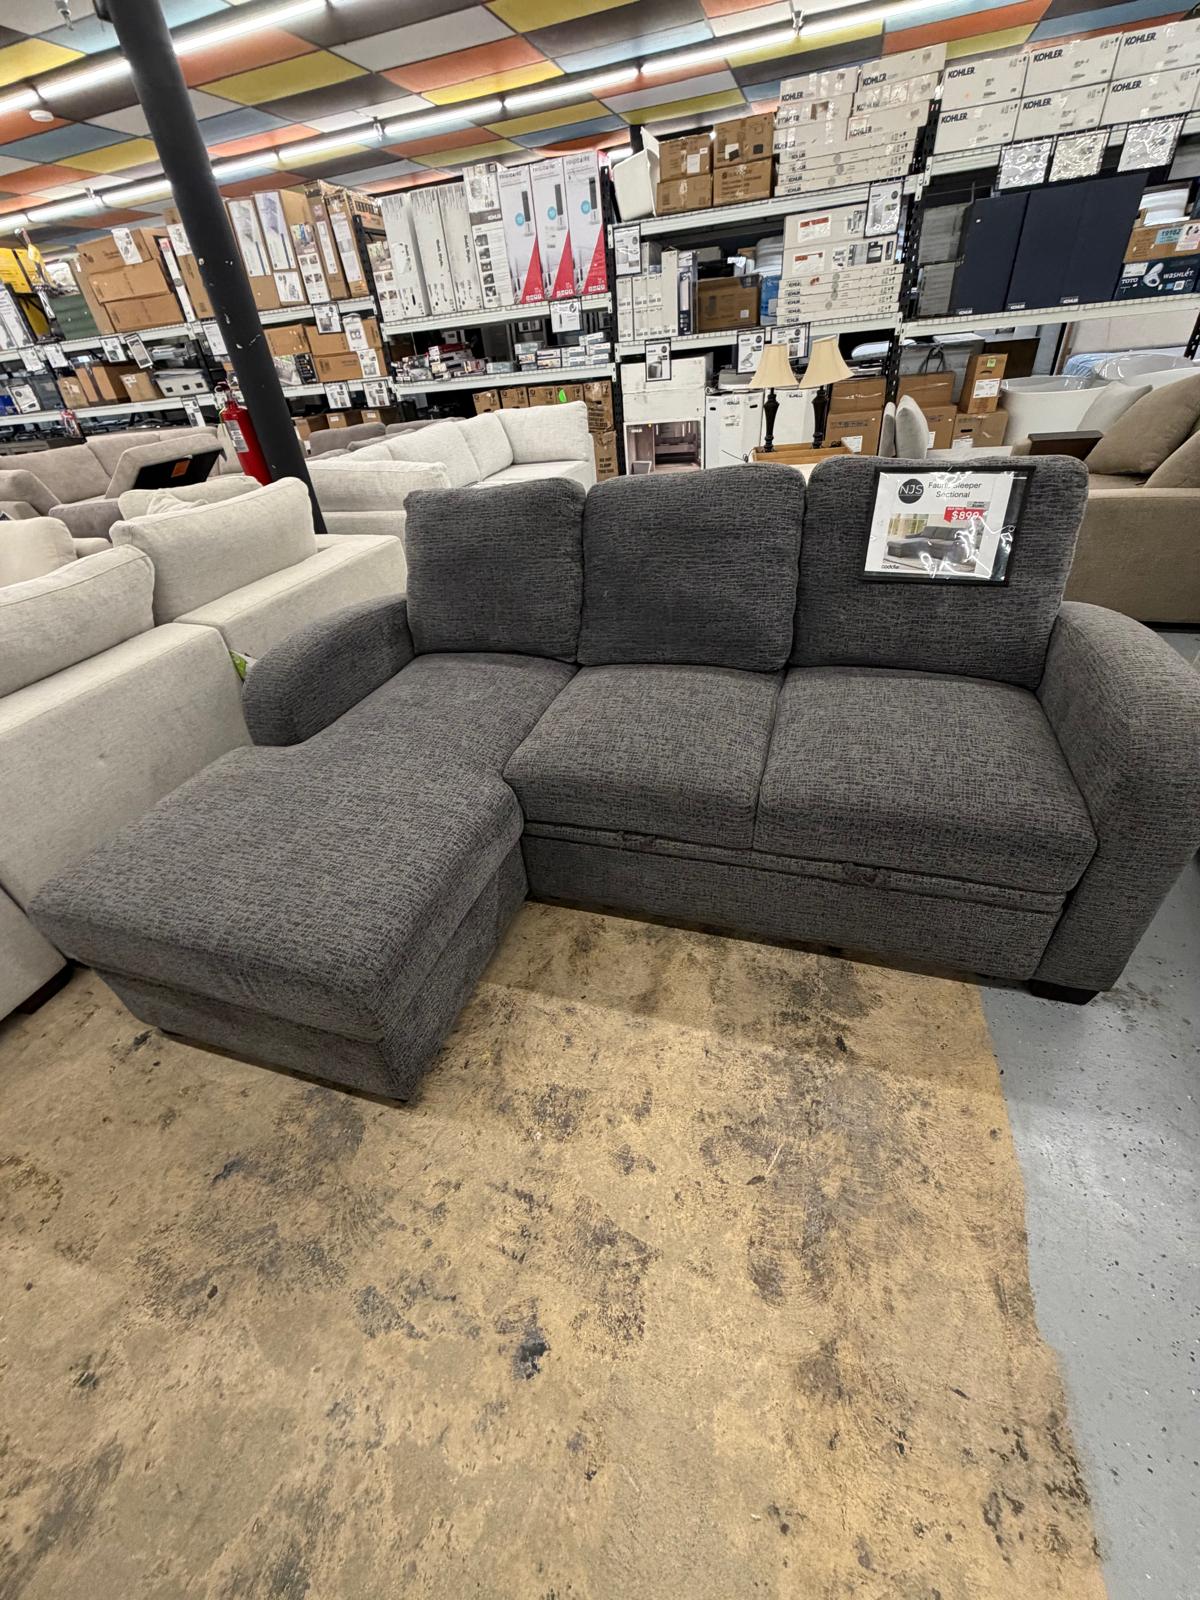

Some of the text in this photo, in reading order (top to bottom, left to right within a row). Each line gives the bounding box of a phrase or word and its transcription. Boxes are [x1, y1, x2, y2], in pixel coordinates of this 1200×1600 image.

[1124, 32, 1157, 46] KOHLER
[1033, 49, 1063, 62] KOHLER
[947, 66, 975, 79] KOHLER
[862, 73, 887, 86] KOHLER
[1111, 80, 1142, 93] KOHLER
[781, 91, 804, 102] KOHLER
[1022, 98, 1052, 110] KOHLER
[940, 112, 968, 124] KOHLER
[900, 484, 924, 496] NJS
